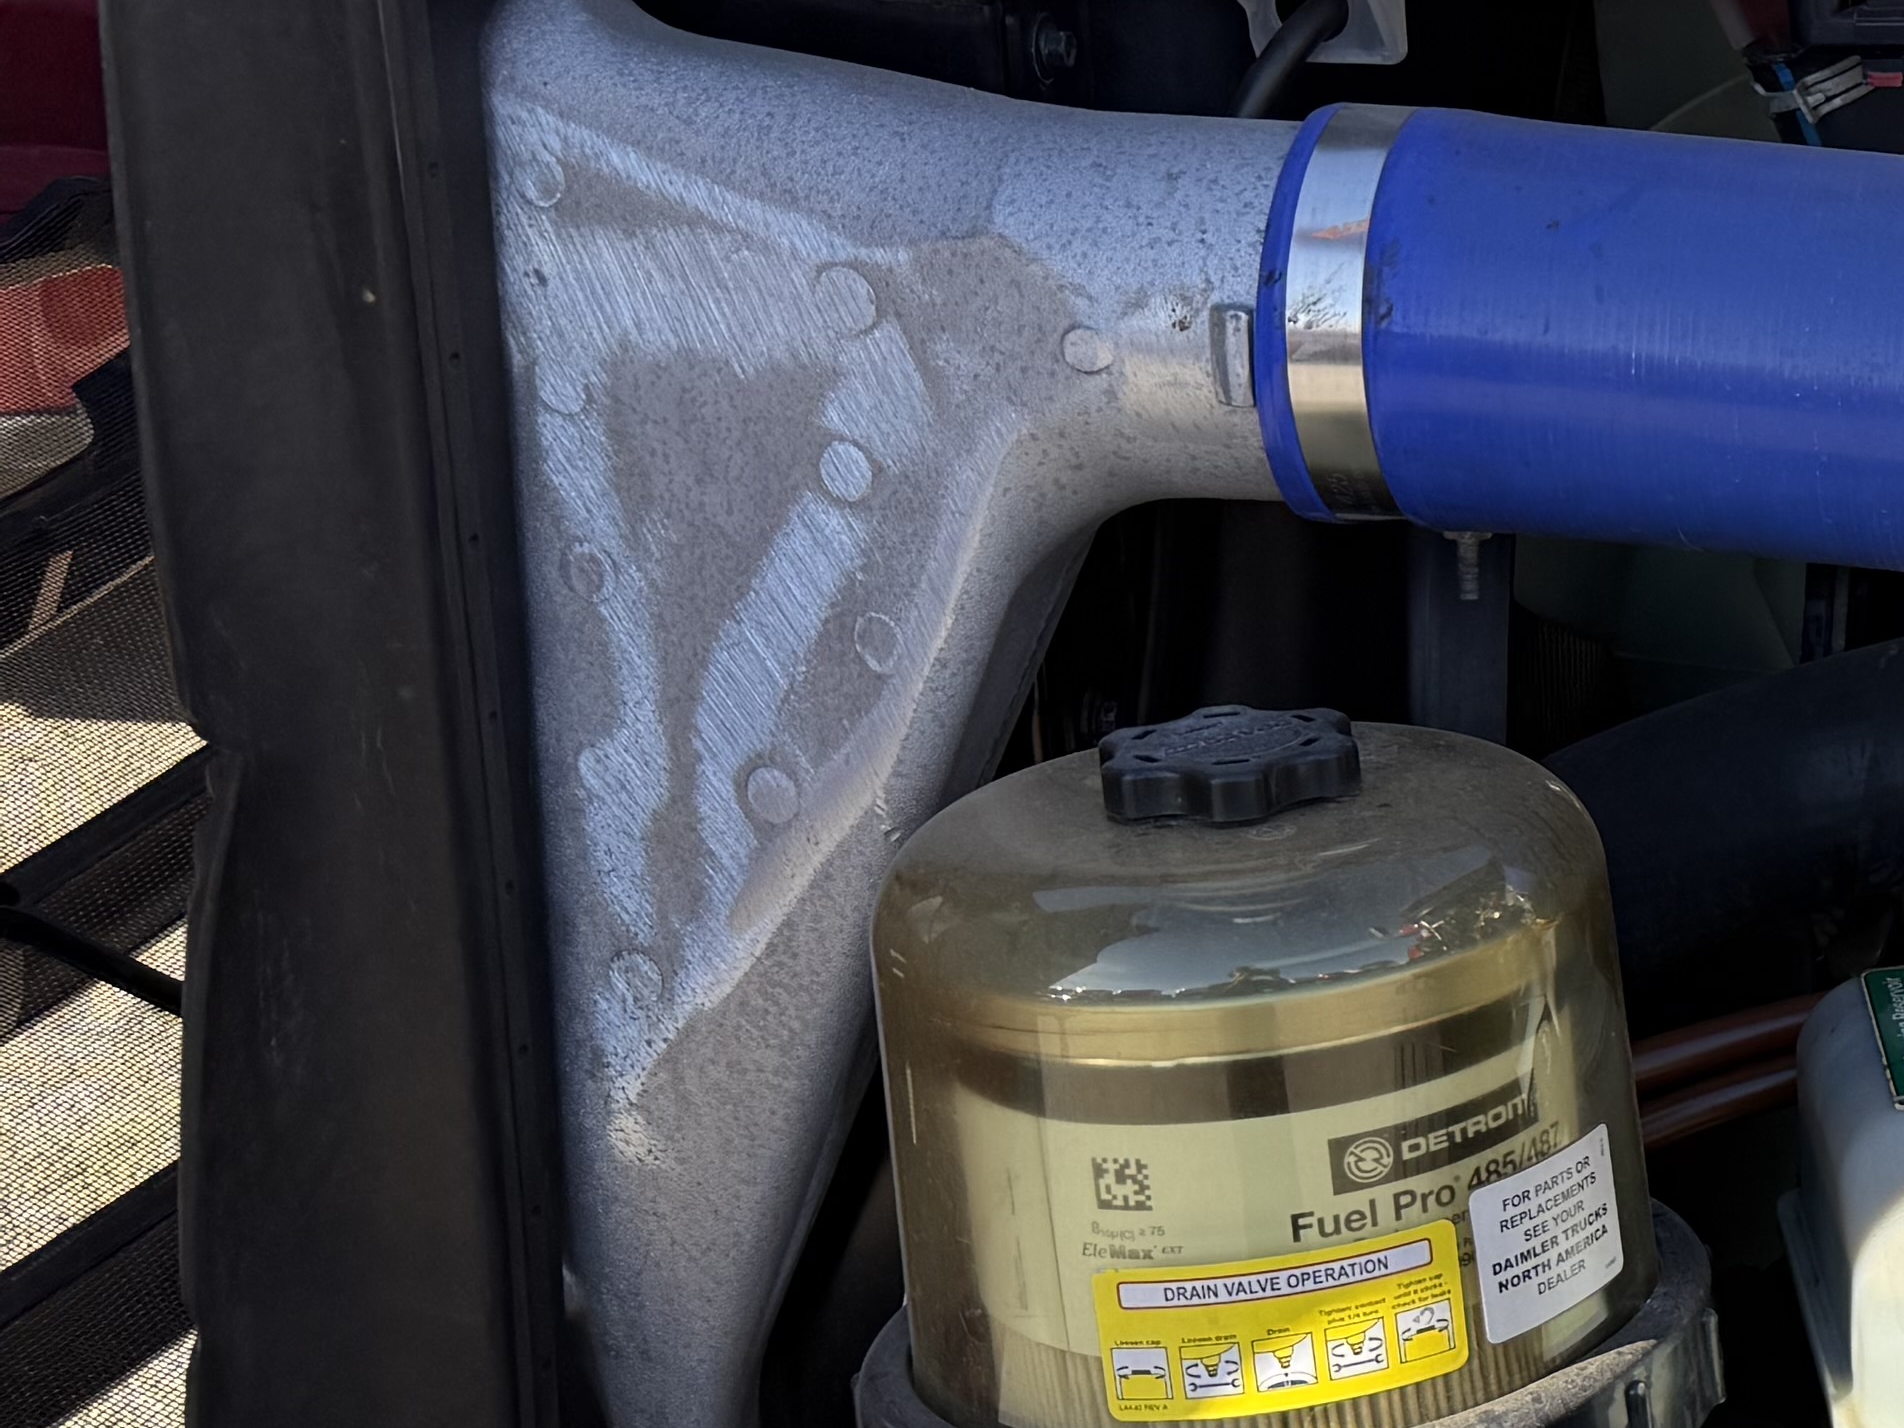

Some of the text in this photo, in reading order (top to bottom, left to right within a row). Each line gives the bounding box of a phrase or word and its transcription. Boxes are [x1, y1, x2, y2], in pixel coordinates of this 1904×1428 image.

[1401, 1095, 1531, 1161] DETROIT
[1290, 1198, 1379, 1243] Fuel
[1392, 1184, 1456, 1221] Pro
[1467, 1121, 1560, 1191] 485/487
[1499, 1172, 1597, 1233] REPLACEMENTS
[1502, 1156, 1591, 1212] FOR PARTS OR
[1492, 1235, 1559, 1276] DAIMLER
[1562, 1203, 1608, 1242] TRUCKS
[1524, 1200, 1585, 1242] SEE YOUR
[1082, 1242, 1154, 1260] EleMax
[1498, 1224, 1608, 1293] NORTH AMERICA
[1164, 1256, 1389, 1302] DRAIN VALVE OPERATION
[1397, 1278, 1427, 1289] Tighten
[1537, 1259, 1586, 1295] DEALER
[1392, 1300, 1415, 1309] check
[1215, 1334, 1237, 1342] drain
[1267, 1327, 1290, 1335] Drain
